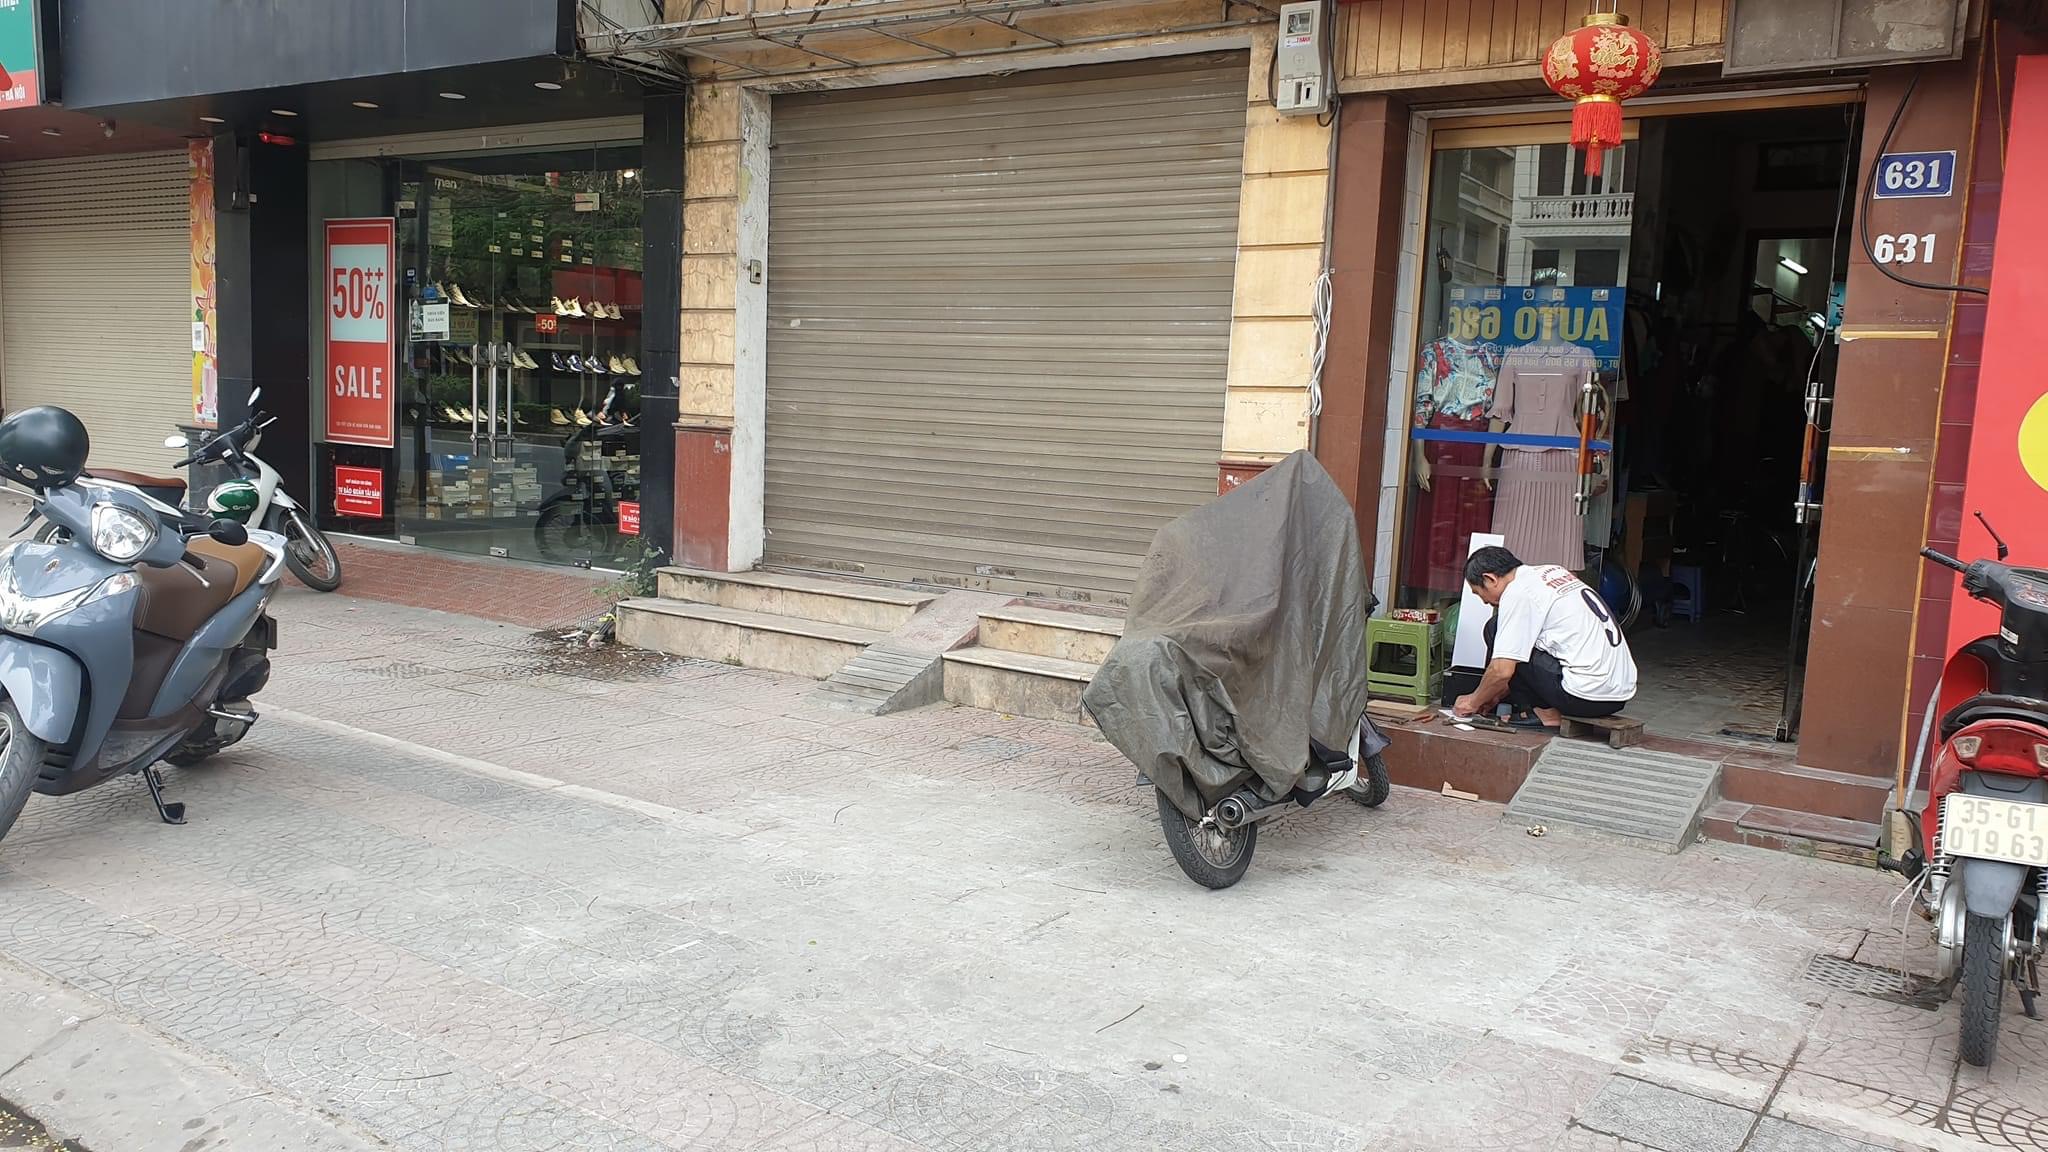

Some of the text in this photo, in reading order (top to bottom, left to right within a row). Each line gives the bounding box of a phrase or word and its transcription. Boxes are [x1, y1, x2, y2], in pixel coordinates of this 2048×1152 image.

[1885, 160, 1941, 189] 631
[1874, 233, 1936, 263] 631
[335, 365, 382, 399] SALE
[1581, 588, 1622, 647] 9
[1961, 800, 2036, 832] 35-G1
[1950, 826, 2045, 861] 019.63
